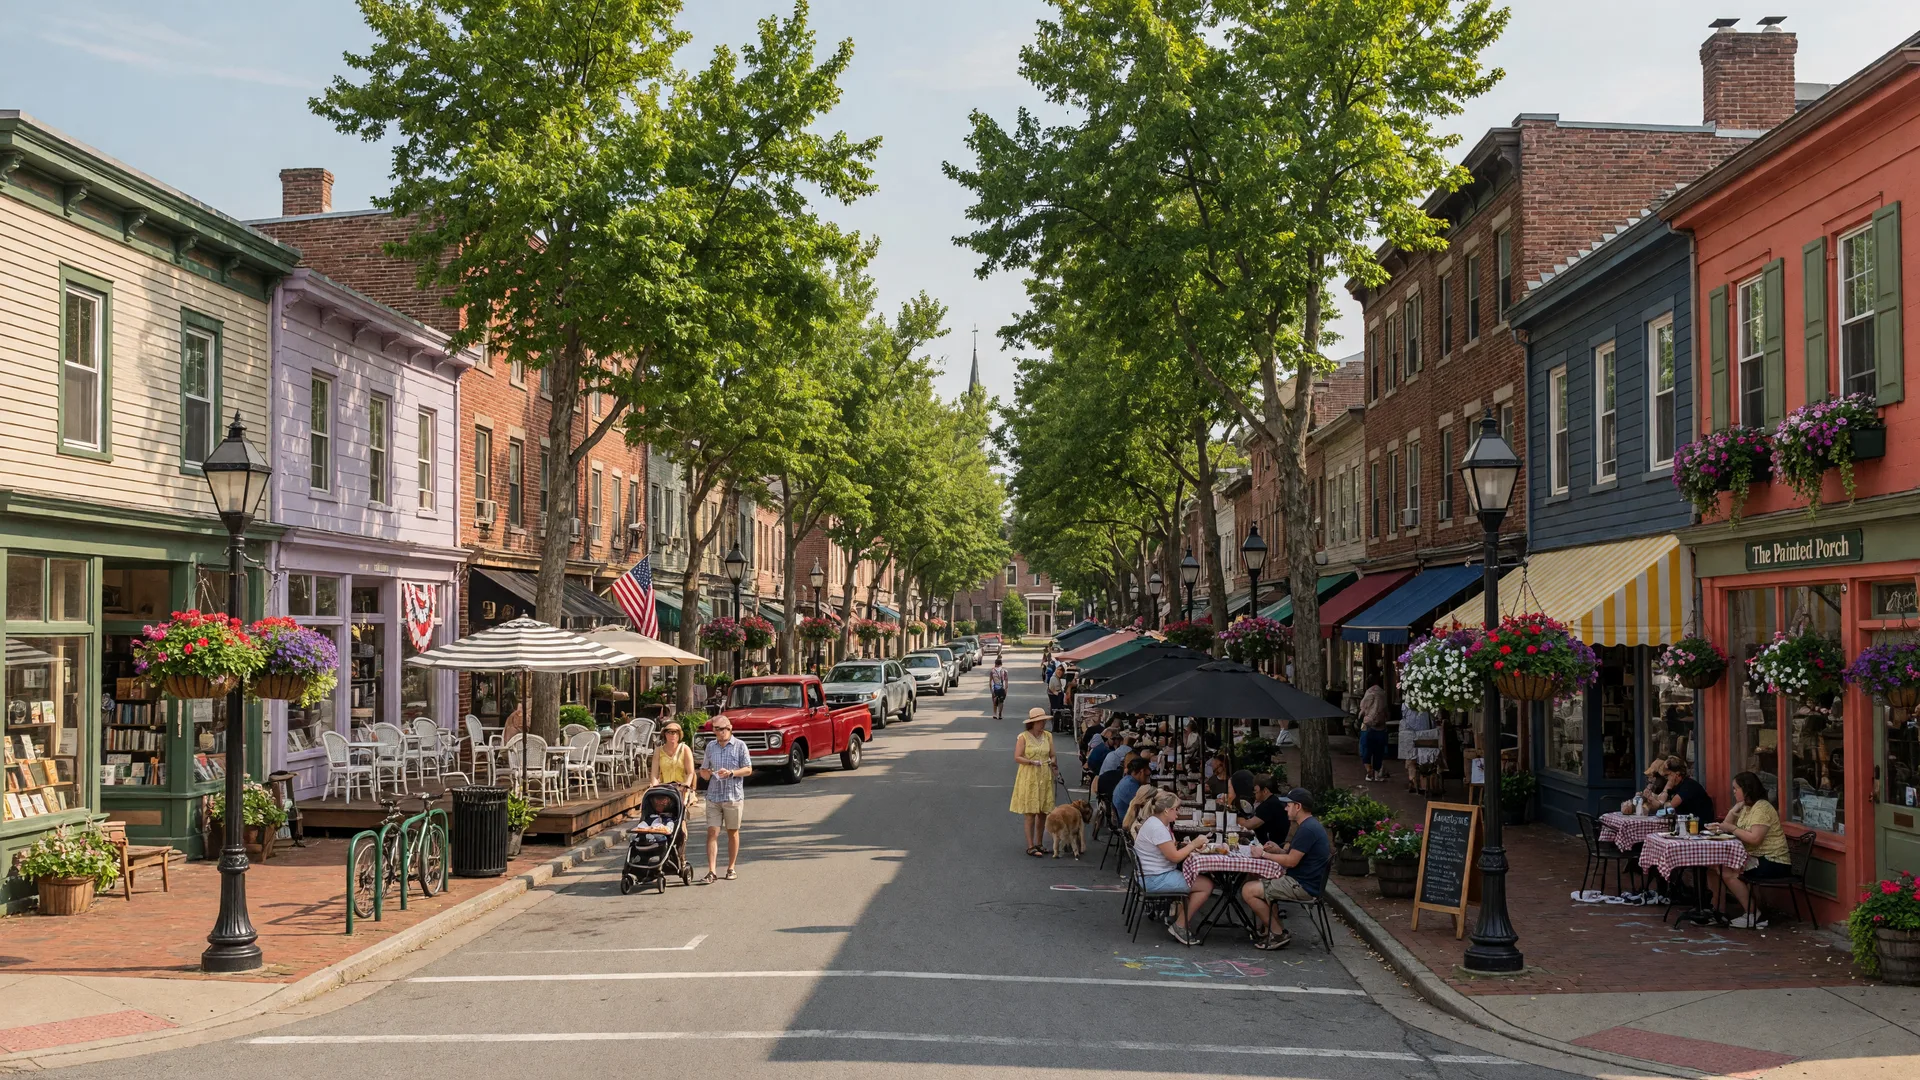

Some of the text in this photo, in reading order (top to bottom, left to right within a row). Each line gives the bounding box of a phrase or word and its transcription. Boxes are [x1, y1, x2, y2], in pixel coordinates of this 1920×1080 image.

[1752, 535, 1849, 564] The Painted Porch
